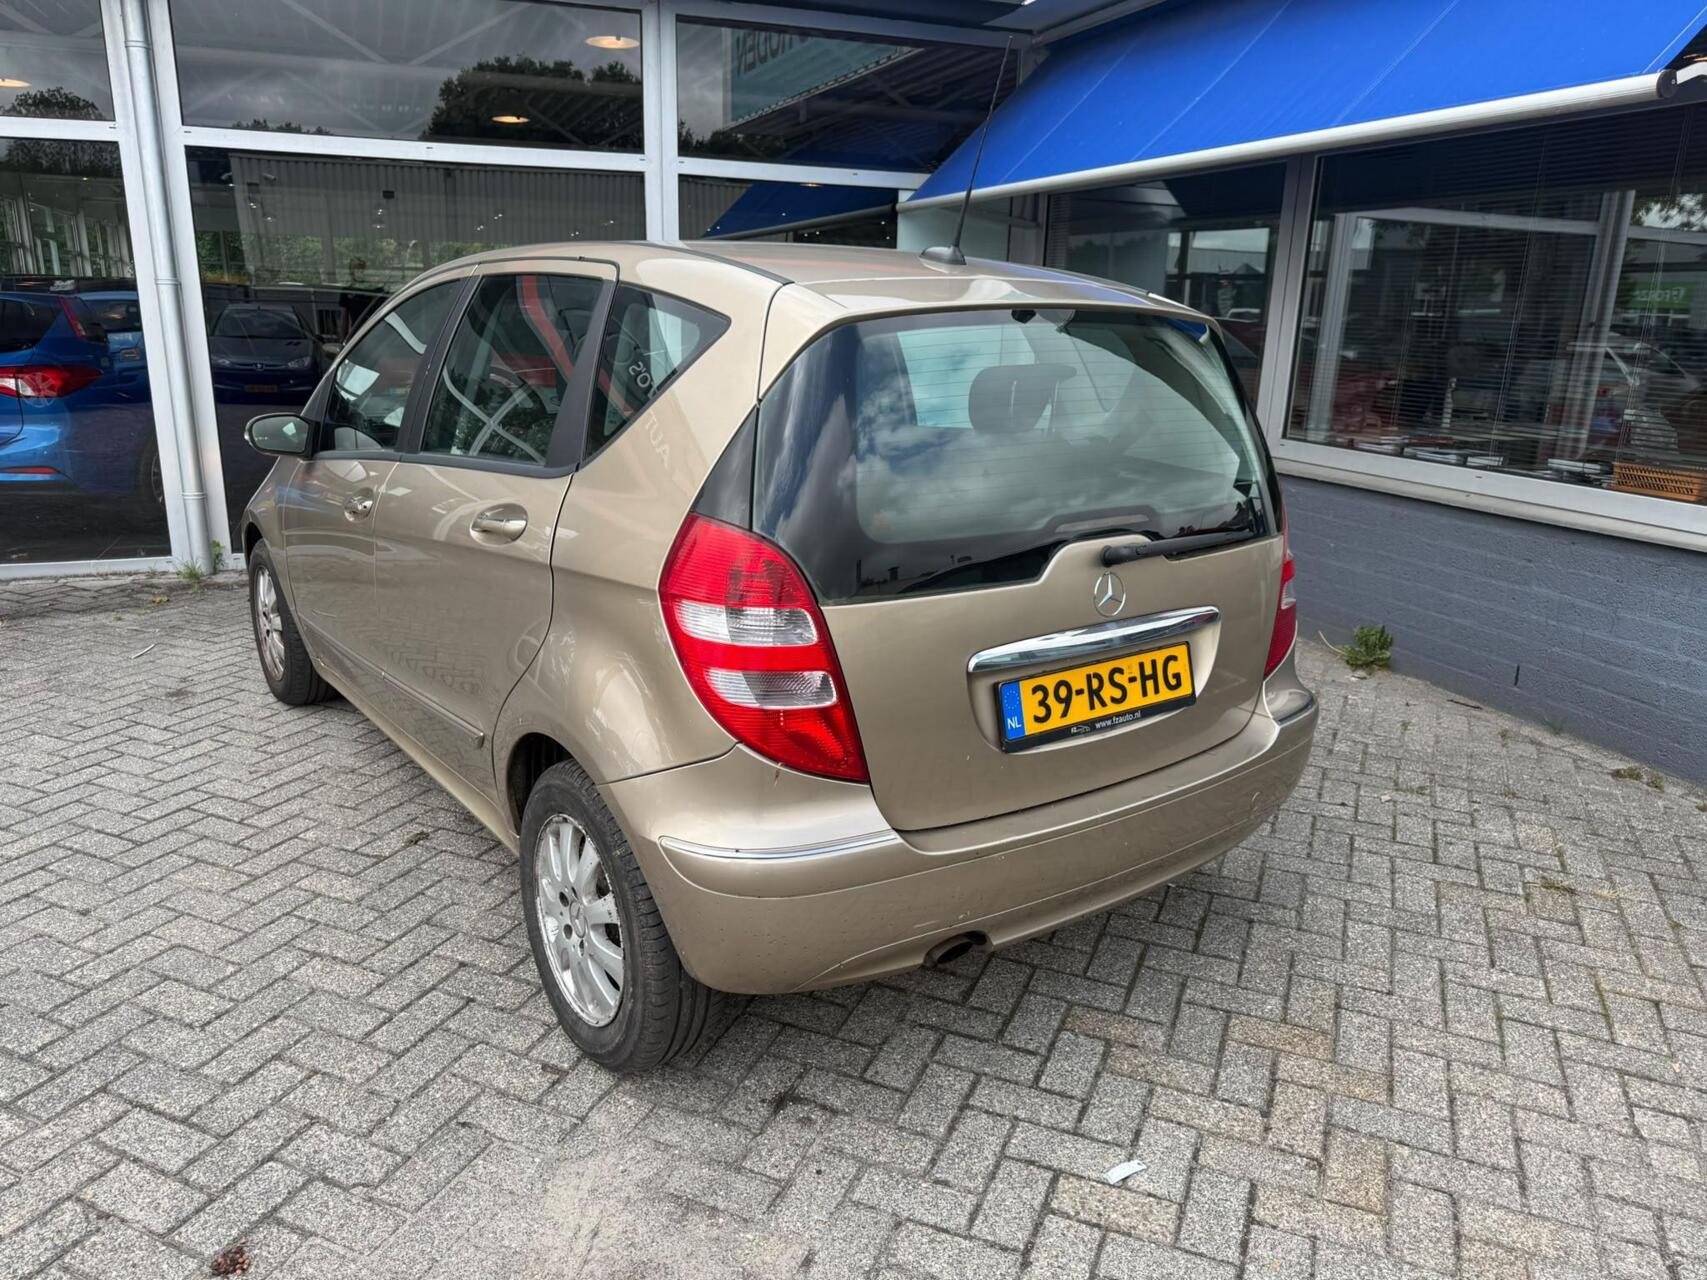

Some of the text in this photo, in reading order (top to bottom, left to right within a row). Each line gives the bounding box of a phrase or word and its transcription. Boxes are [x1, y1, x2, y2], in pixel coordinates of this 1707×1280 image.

[1031, 654, 1182, 724] 39-RS-HG
[1007, 716, 1022, 730] NL
[1094, 710, 1141, 729] www.fzauto.nl
